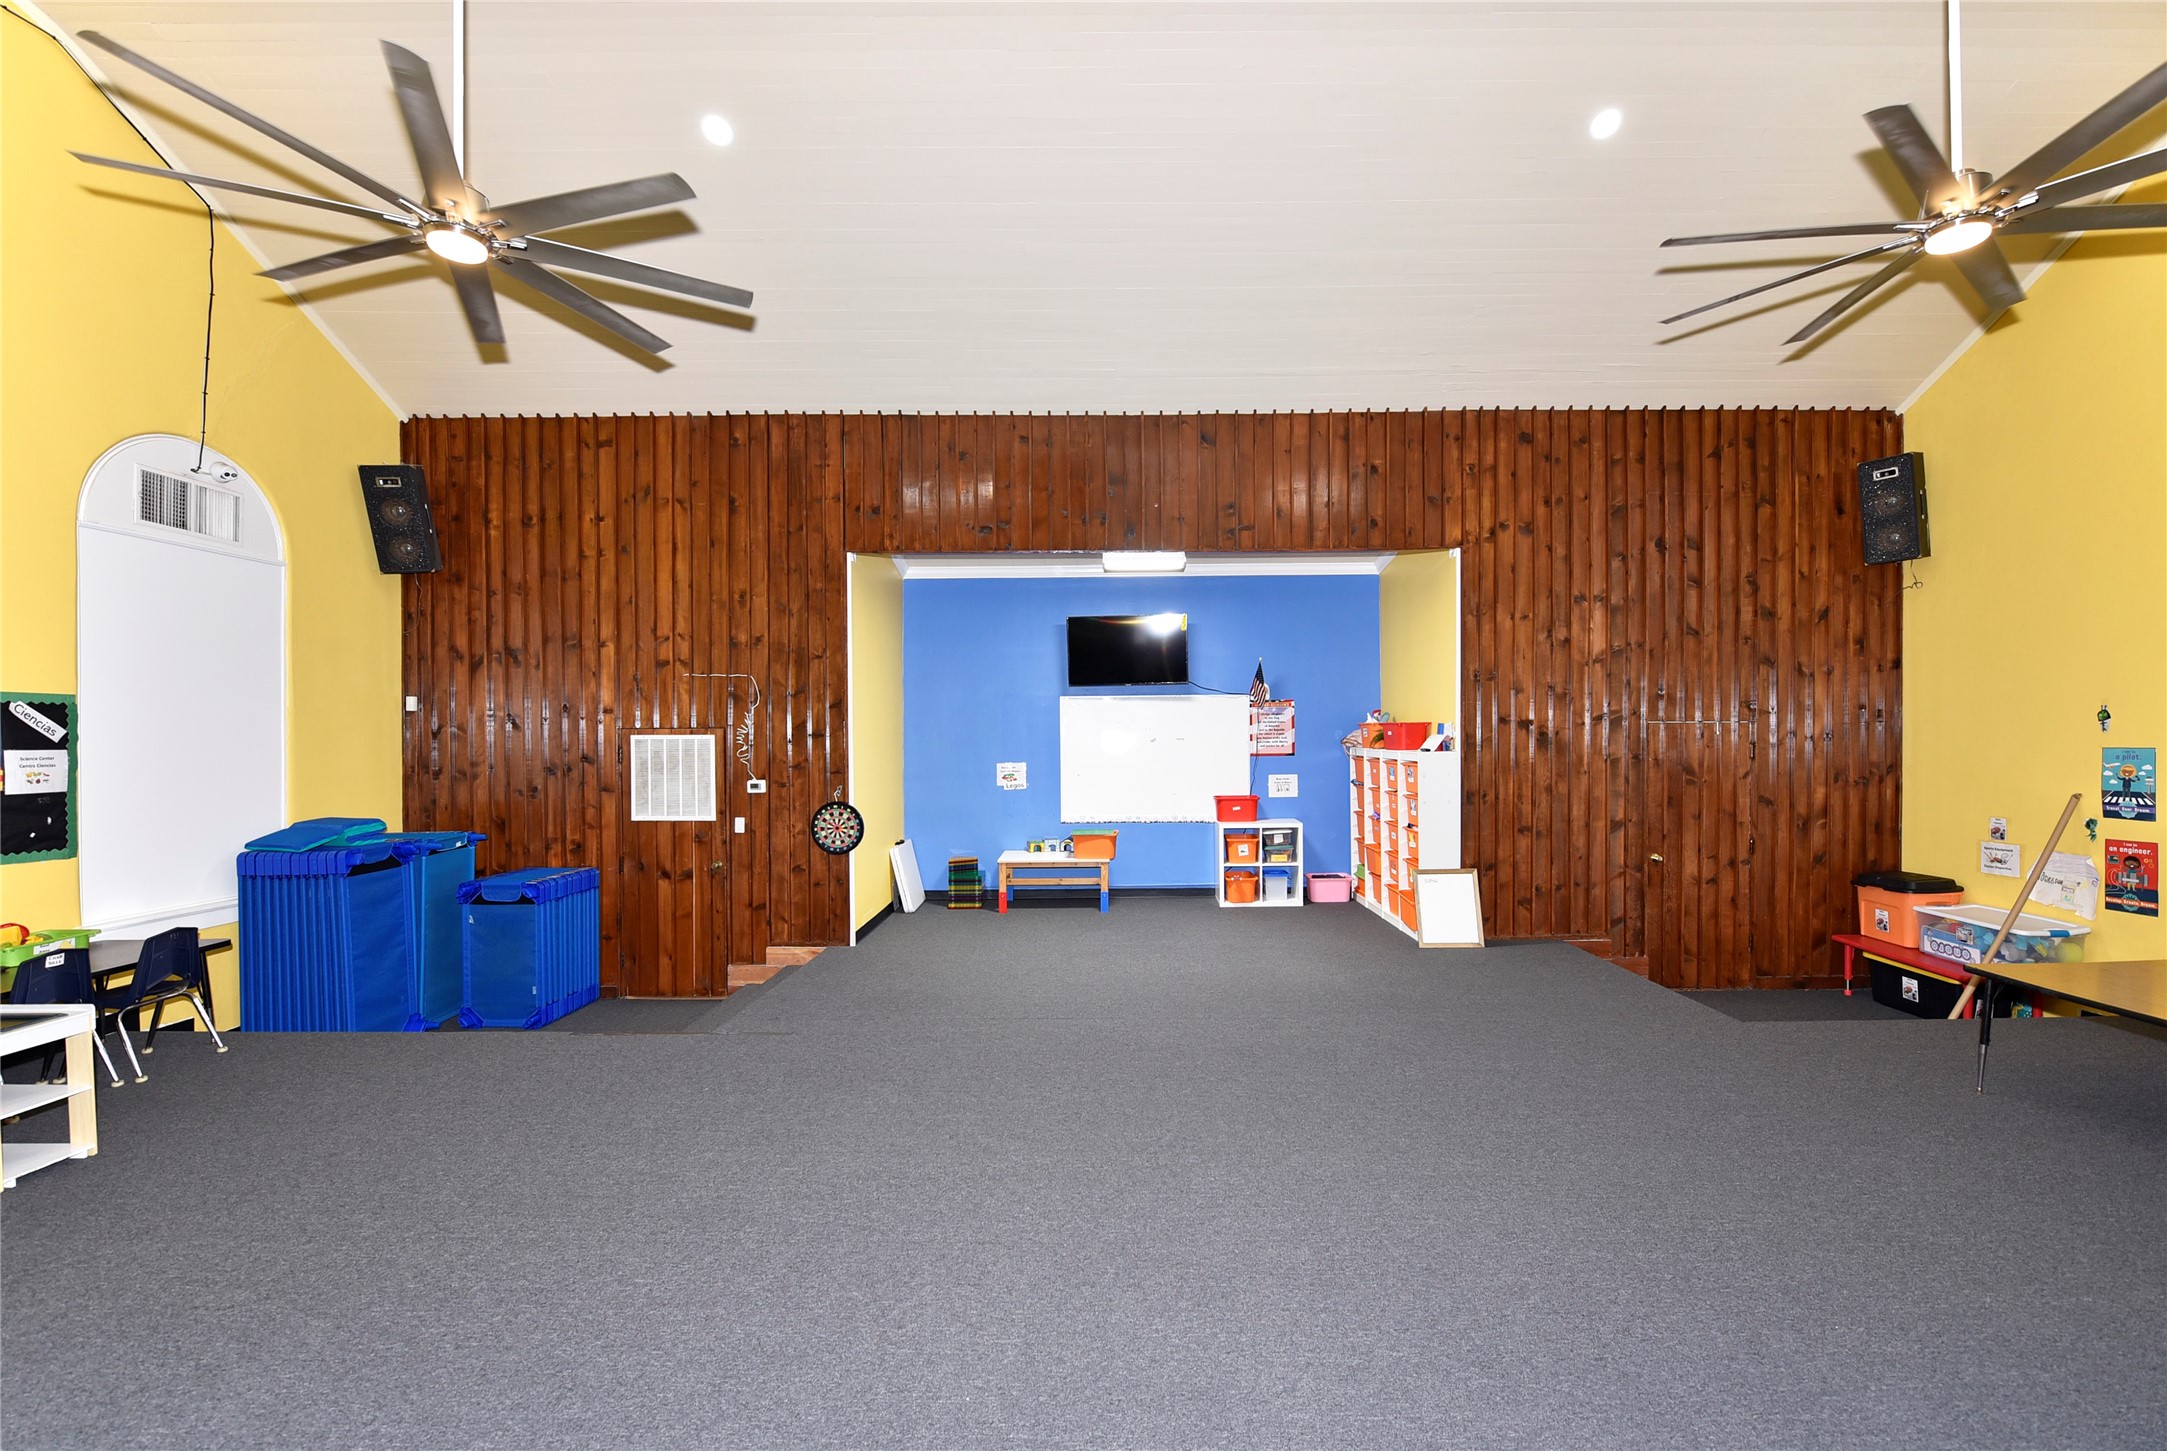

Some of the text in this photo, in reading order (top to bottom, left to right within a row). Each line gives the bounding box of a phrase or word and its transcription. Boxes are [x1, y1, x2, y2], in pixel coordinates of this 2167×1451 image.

[14, 703, 57, 737] Ciencias
[2122, 753, 2142, 761] pilot.
[1006, 782, 1024, 790] Legos
[2119, 846, 2153, 856] engineer.
